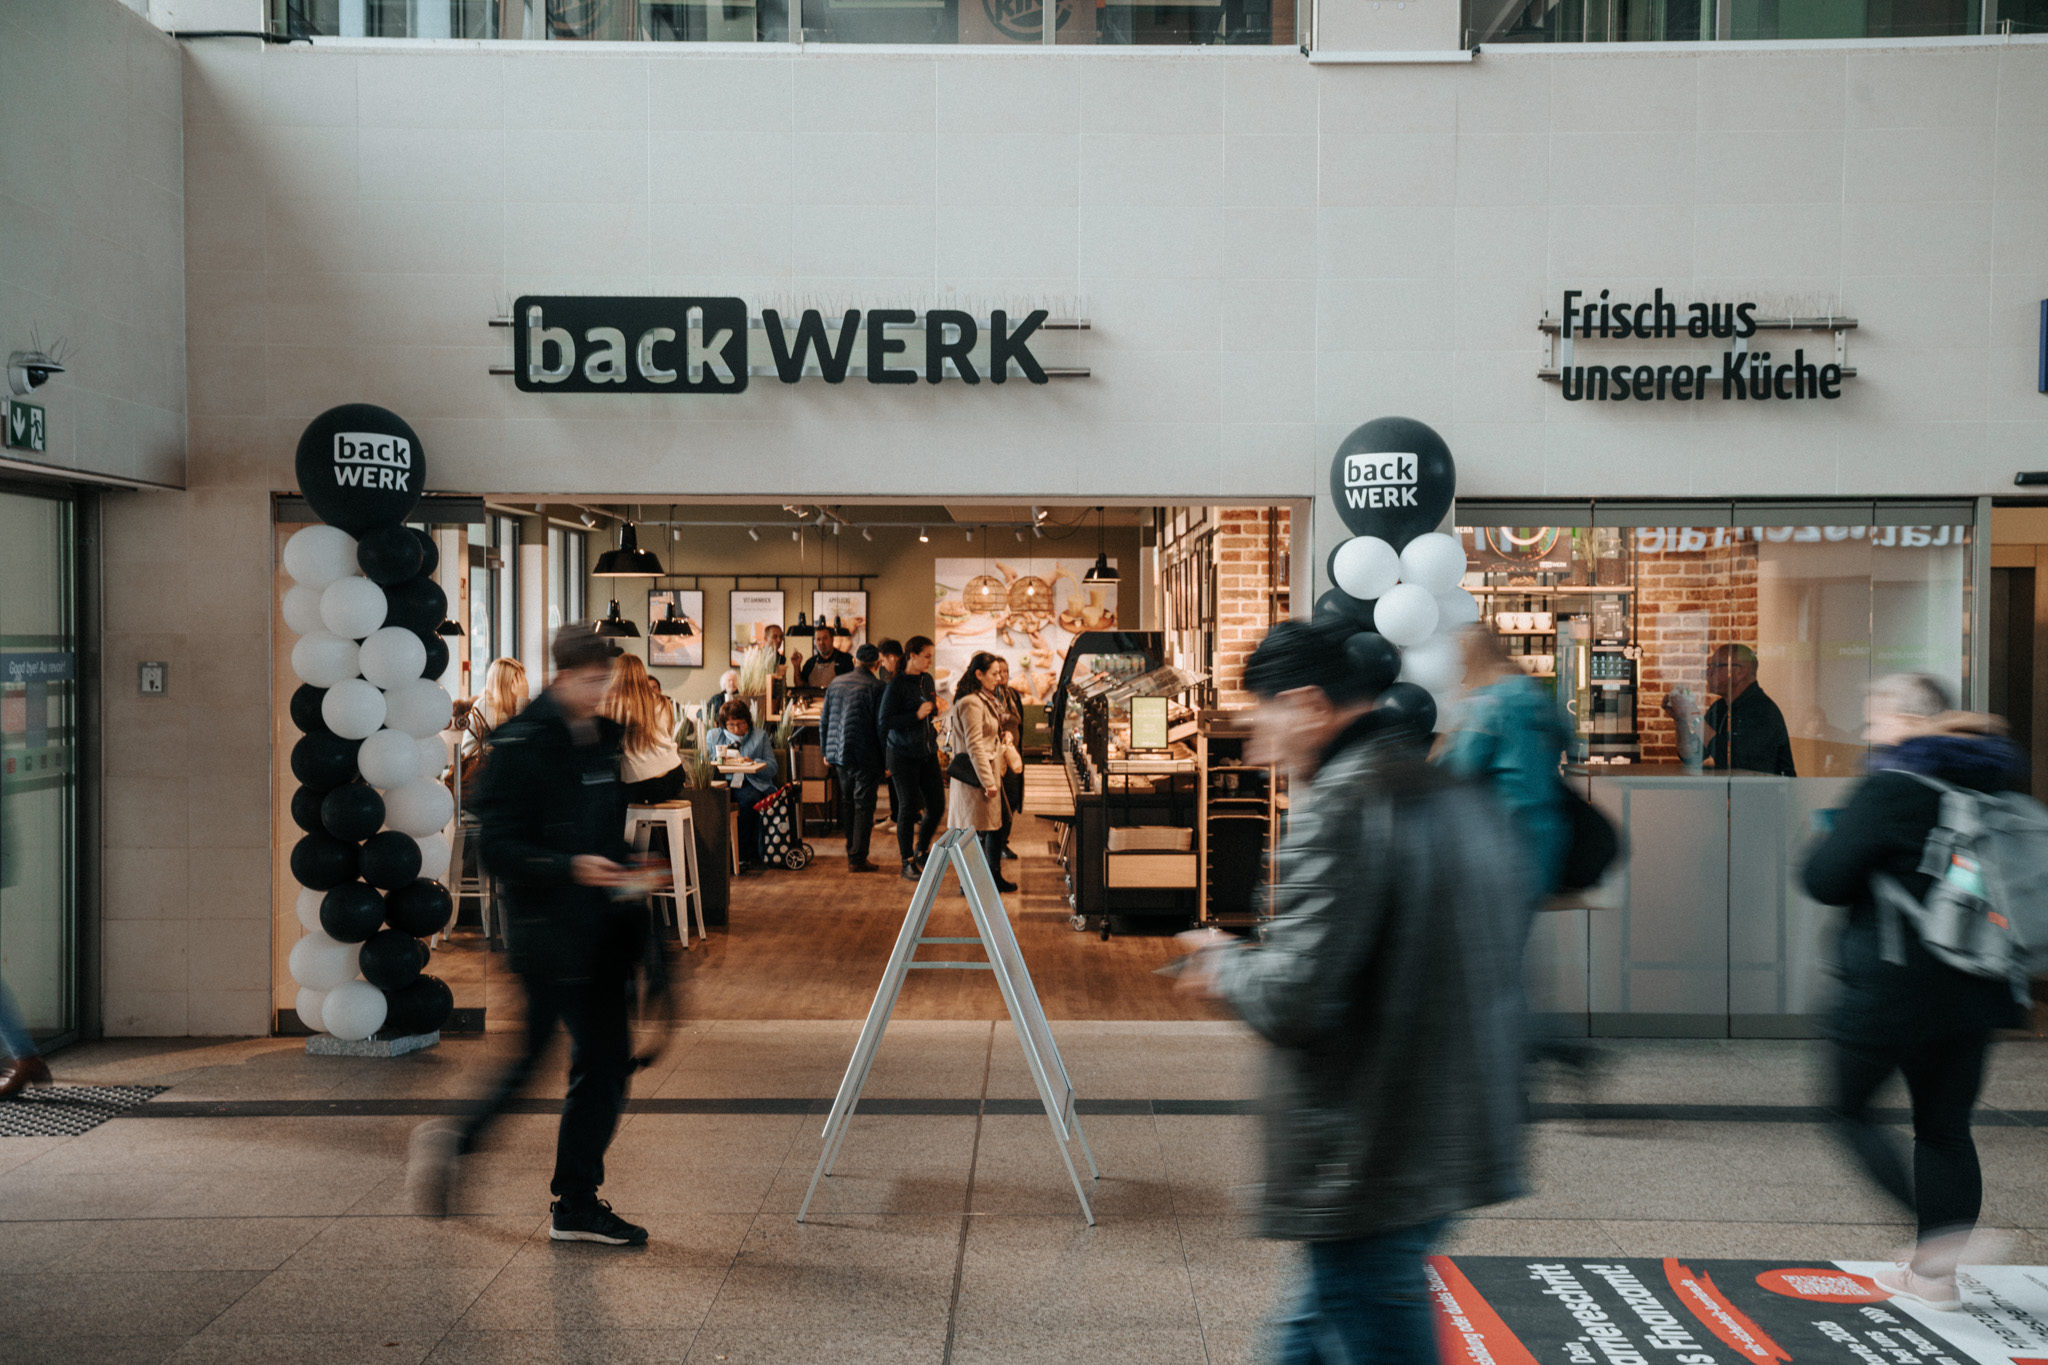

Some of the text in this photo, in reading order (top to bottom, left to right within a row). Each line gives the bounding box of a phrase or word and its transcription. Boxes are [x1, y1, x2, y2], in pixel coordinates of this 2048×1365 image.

[1562, 287, 1757, 339] Frisch aus
[526, 304, 1049, 384] back WERK
[1562, 348, 1842, 401] unserer Küche
[338, 435, 408, 465] back
[333, 465, 410, 492] WERK
[1347, 456, 1414, 483] back
[1344, 486, 1419, 509] WERK
[9, 660, 26, 675] Good
[40, 660, 48, 673] Au
[1436, 1293, 1463, 1315] duales
[1582, 1264, 1703, 1350] Finanzamt!
[1450, 1315, 1474, 1333] oder
[1811, 1320, 1860, 1344] 2026
[1562, 1342, 1597, 1364] Dein
[1865, 1330, 1924, 1365] bei uns
[1887, 1327, 1945, 1355] Team!
